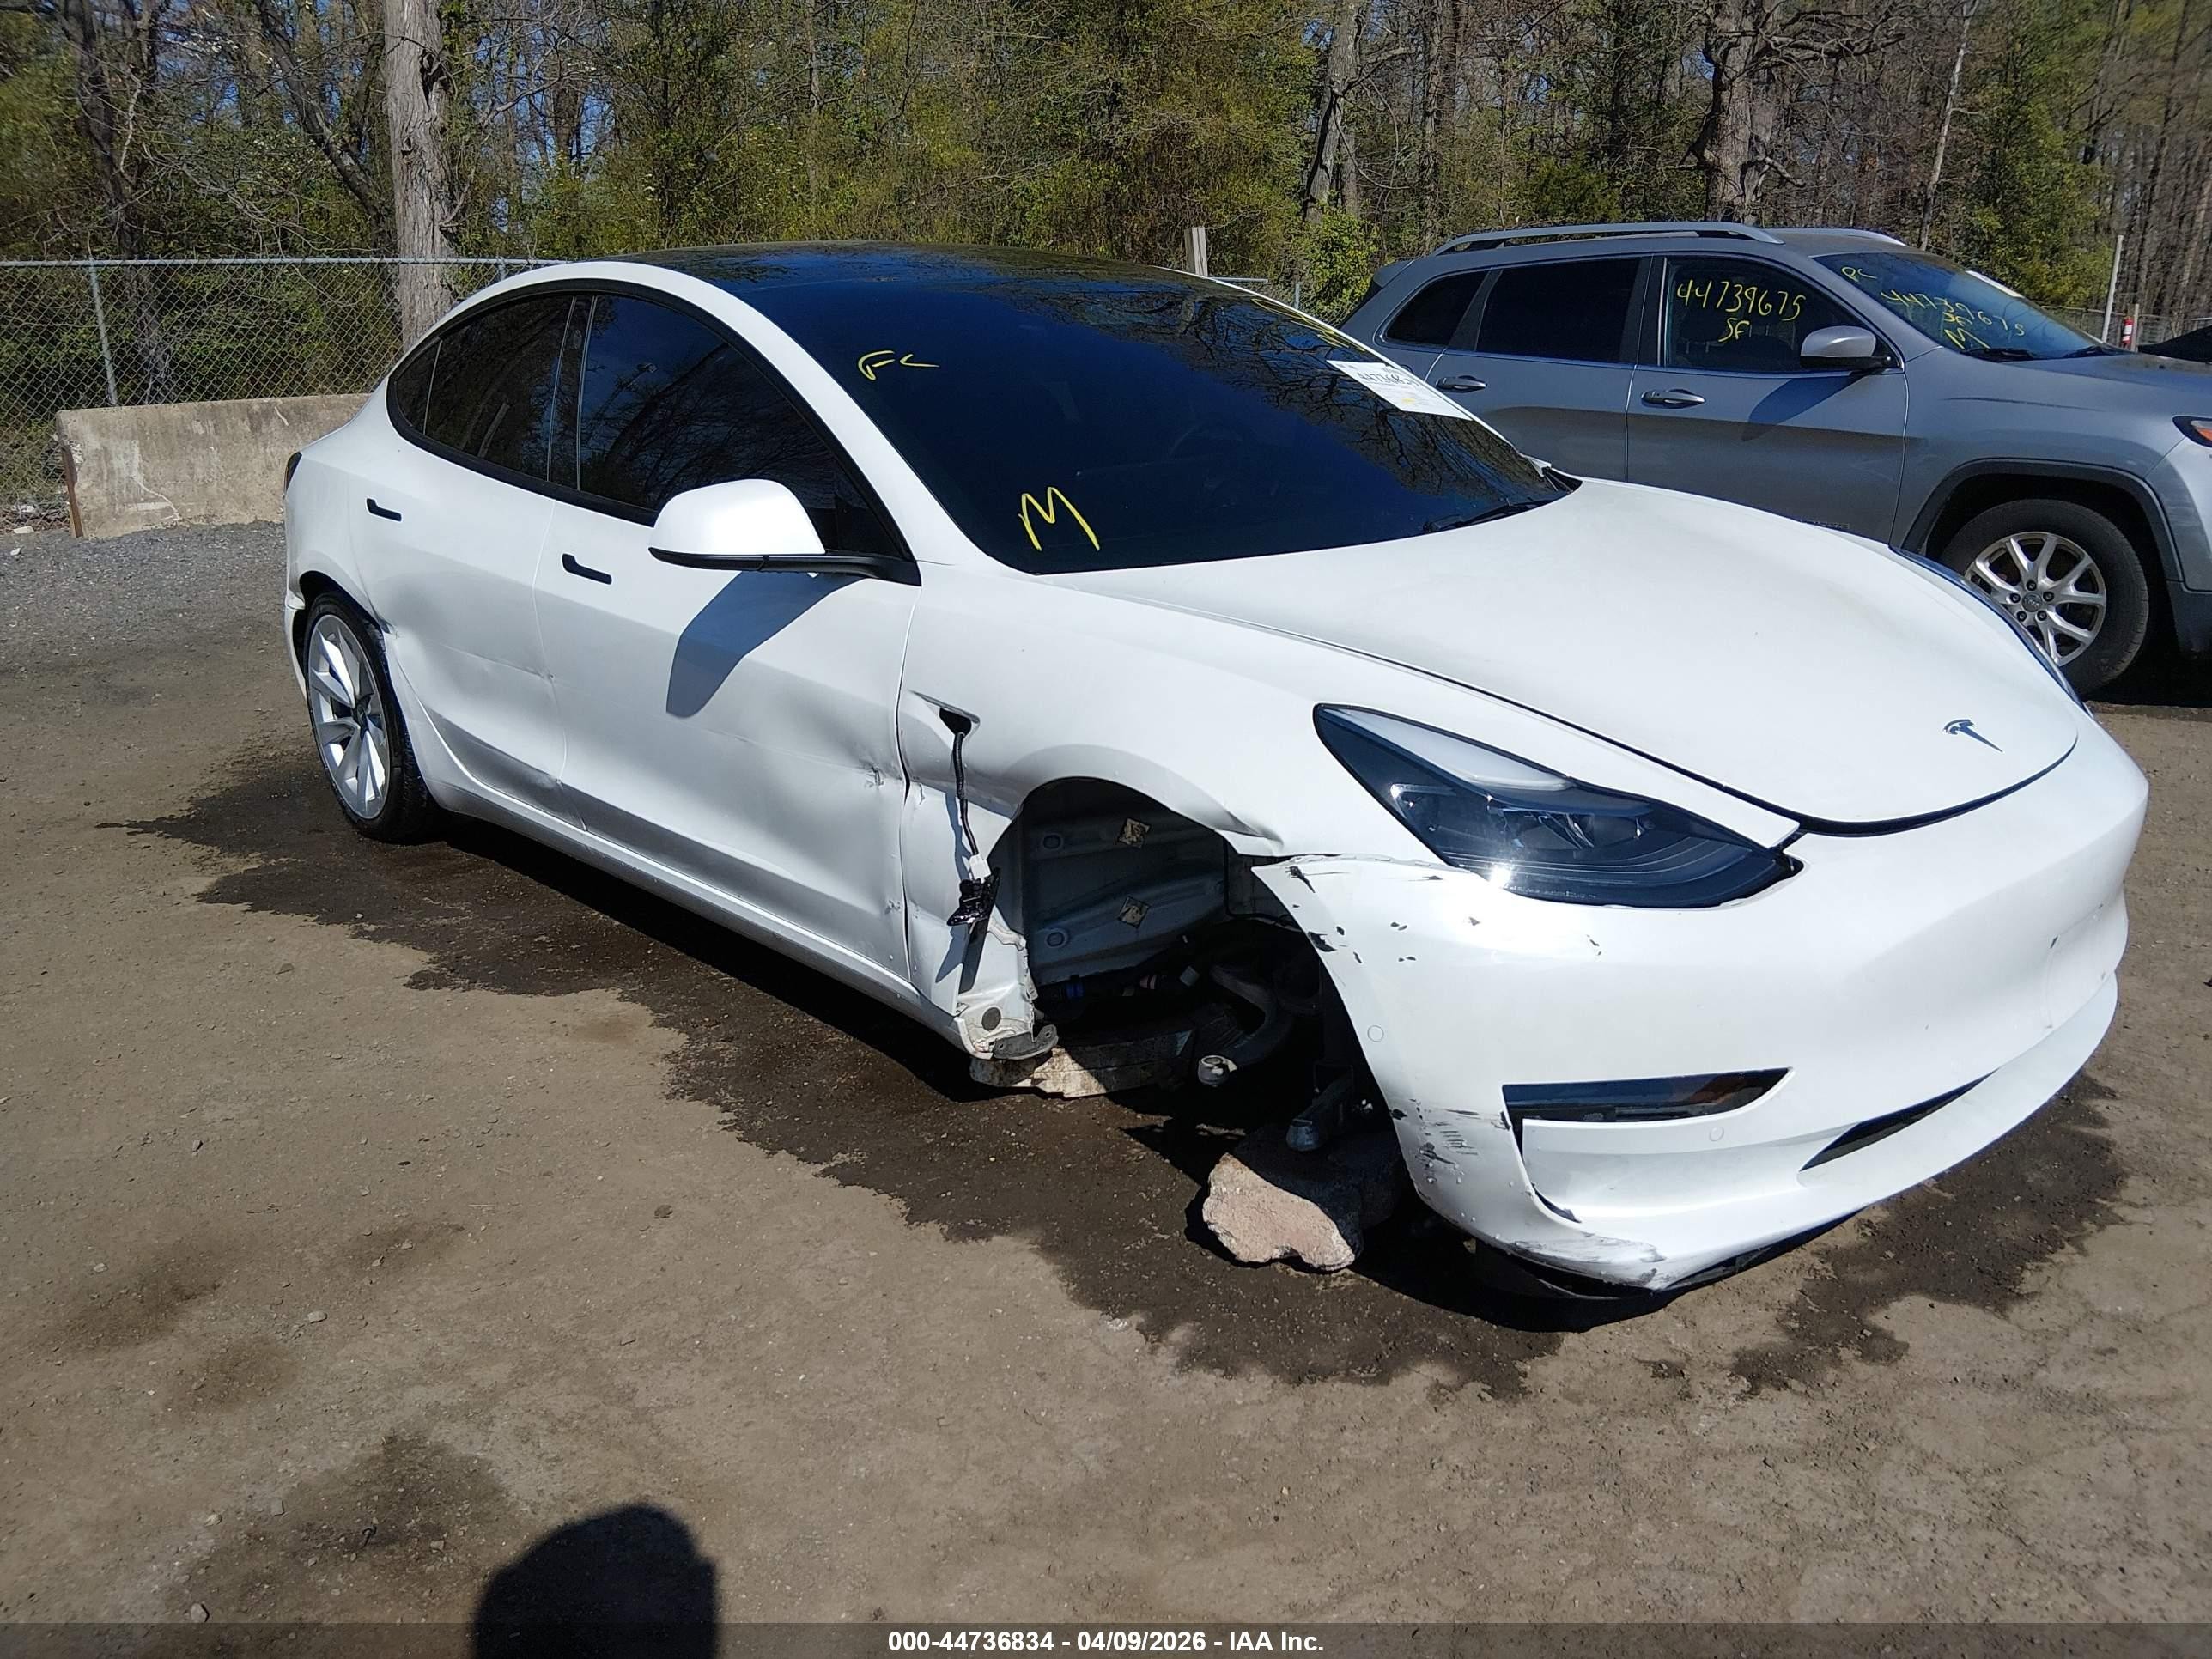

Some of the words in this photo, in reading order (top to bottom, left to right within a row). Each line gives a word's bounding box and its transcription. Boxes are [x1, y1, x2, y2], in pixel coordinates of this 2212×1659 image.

[1677, 279, 1807, 321] 44739675
[1718, 317, 1750, 342] SF
[1944, 327, 1991, 349] M
[1018, 486, 1101, 551] M
